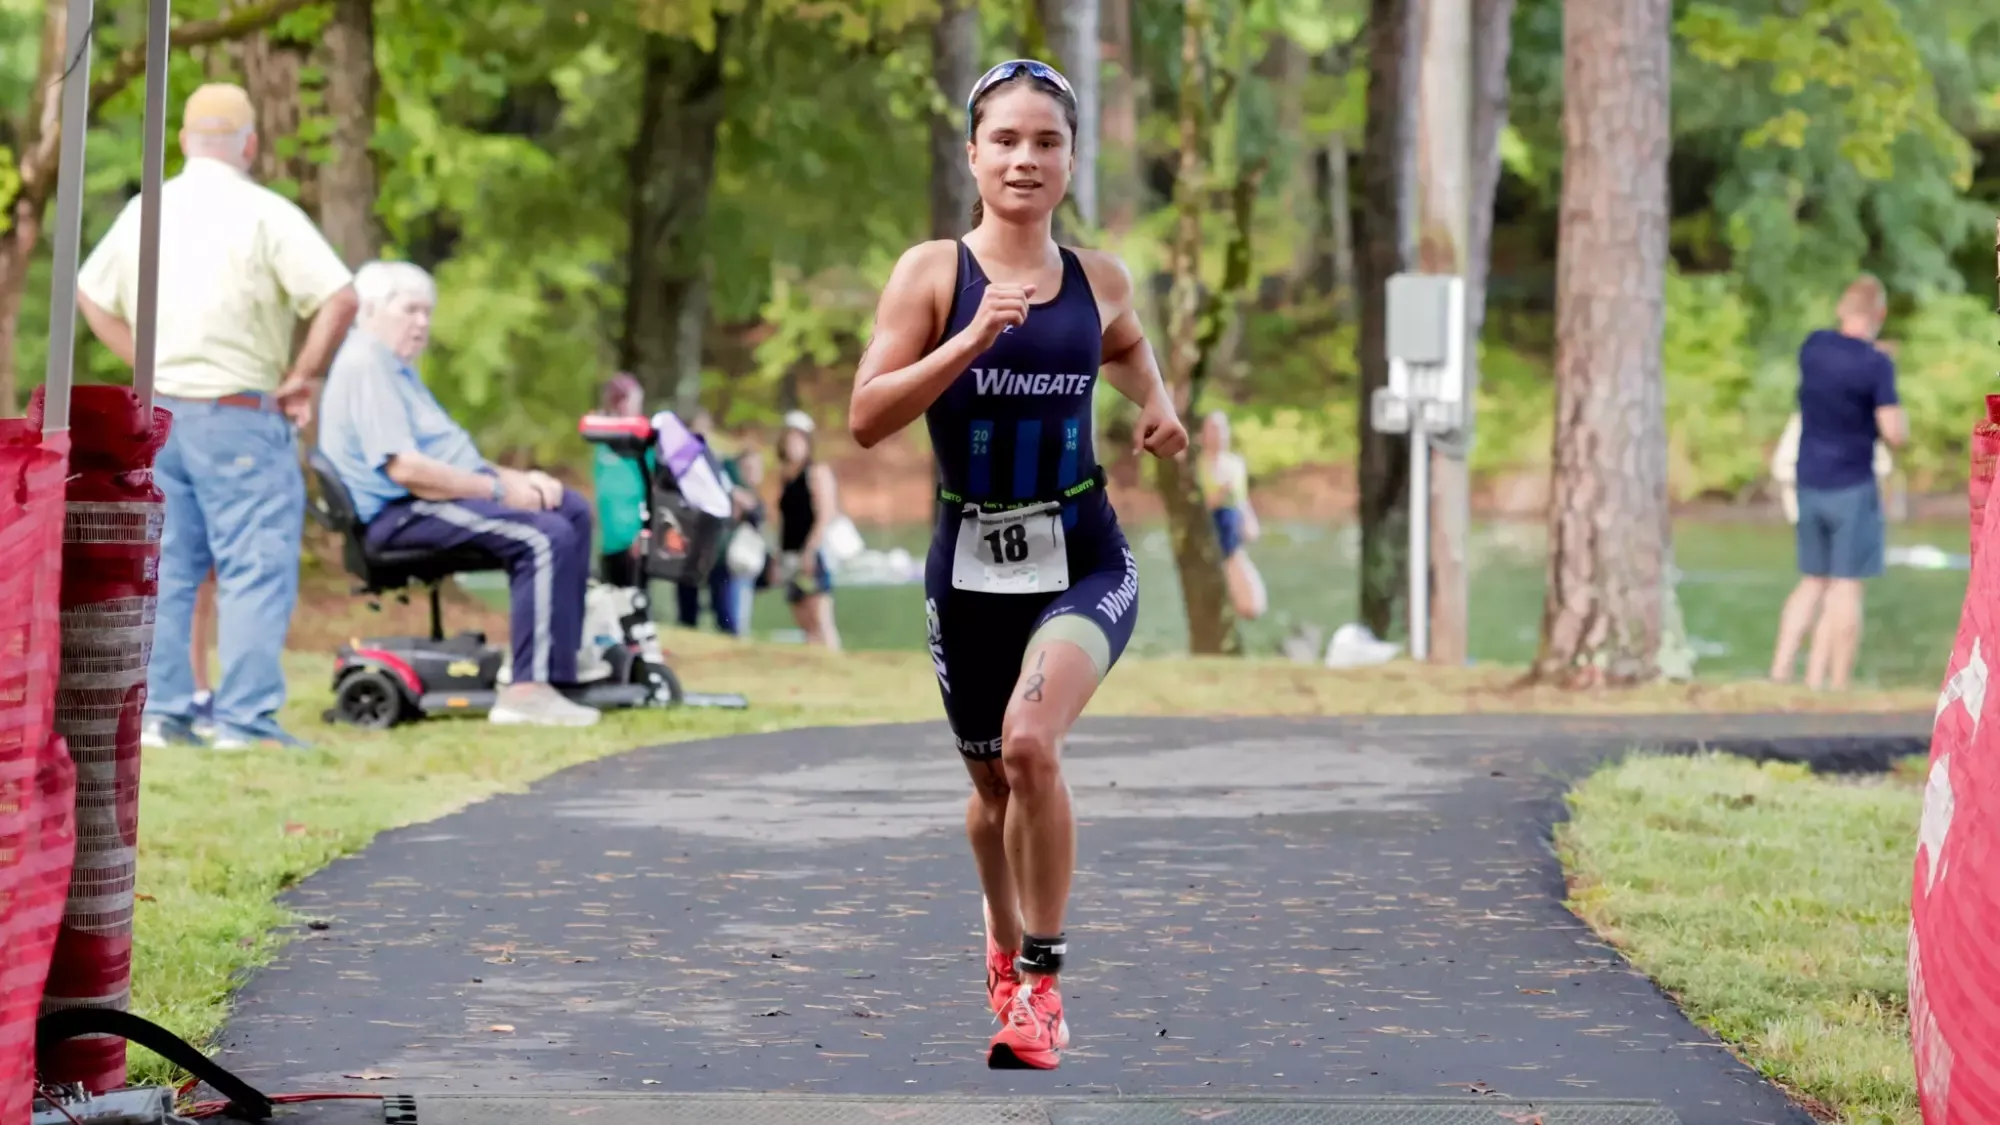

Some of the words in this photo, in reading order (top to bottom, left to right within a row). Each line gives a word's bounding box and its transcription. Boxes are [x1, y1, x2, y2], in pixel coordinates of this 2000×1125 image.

[971, 368, 1091, 396] WINGATE
[973, 429, 989, 442] 20
[984, 524, 1028, 564] 18
